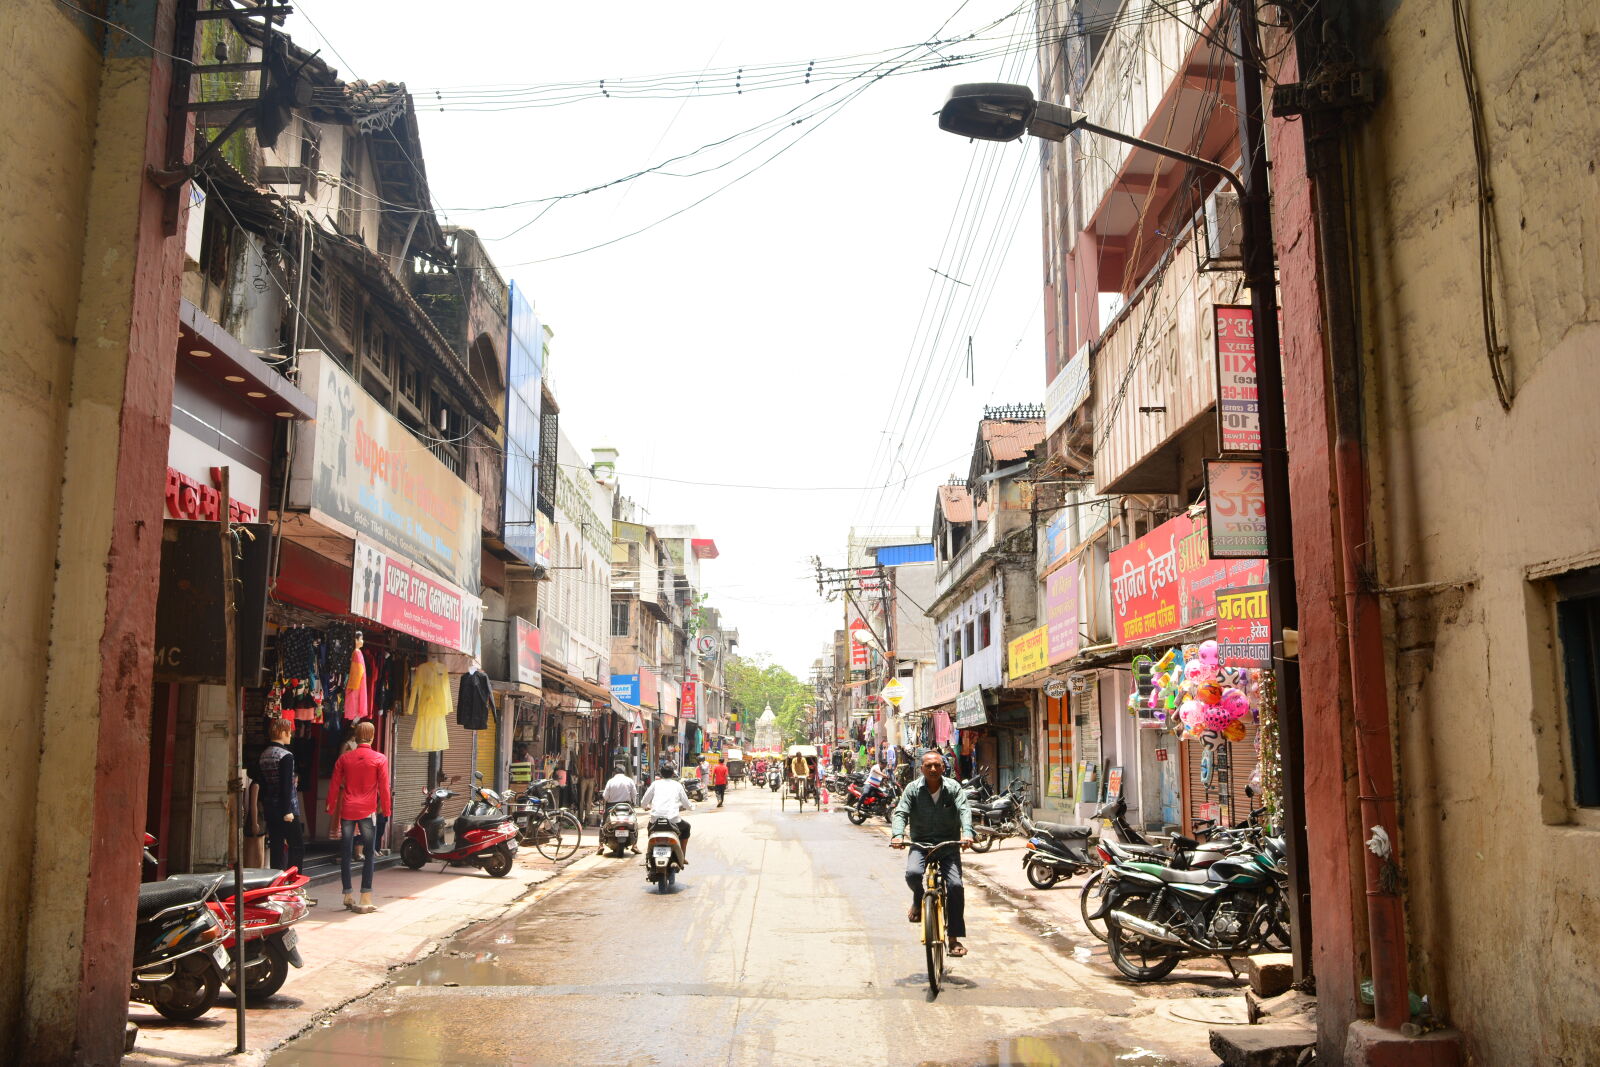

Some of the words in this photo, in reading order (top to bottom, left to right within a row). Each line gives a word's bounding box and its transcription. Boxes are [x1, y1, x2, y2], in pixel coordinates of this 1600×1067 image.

[355, 418, 390, 486] Super
[386, 565, 410, 603] SUPER
[410, 576, 428, 612] STAR
[428, 586, 460, 623] GARMENTS
[1113, 559, 1147, 616] सुनिल
[1146, 533, 1178, 600] ट्रेडर्स
[1217, 590, 1268, 620] जनता
[1218, 636, 1270, 666] युनिफॉर्मवाला
